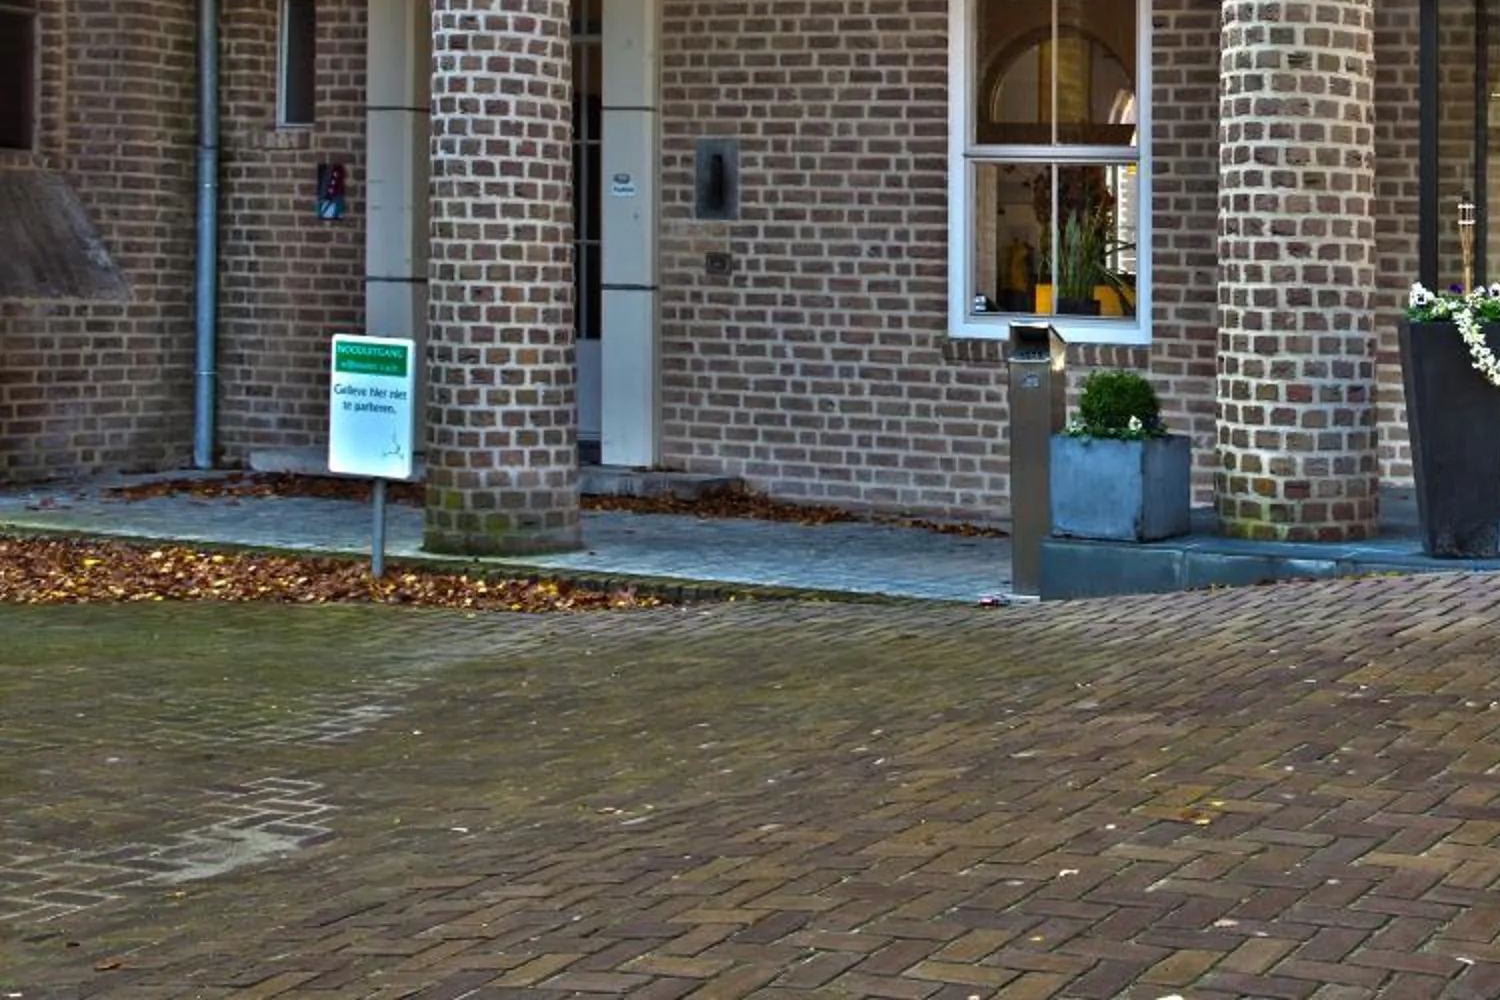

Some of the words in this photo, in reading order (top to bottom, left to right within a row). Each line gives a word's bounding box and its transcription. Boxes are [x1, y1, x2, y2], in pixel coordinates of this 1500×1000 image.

[334, 384, 367, 397] Gelieve
[389, 388, 407, 400] niet
[342, 401, 352, 411] te
